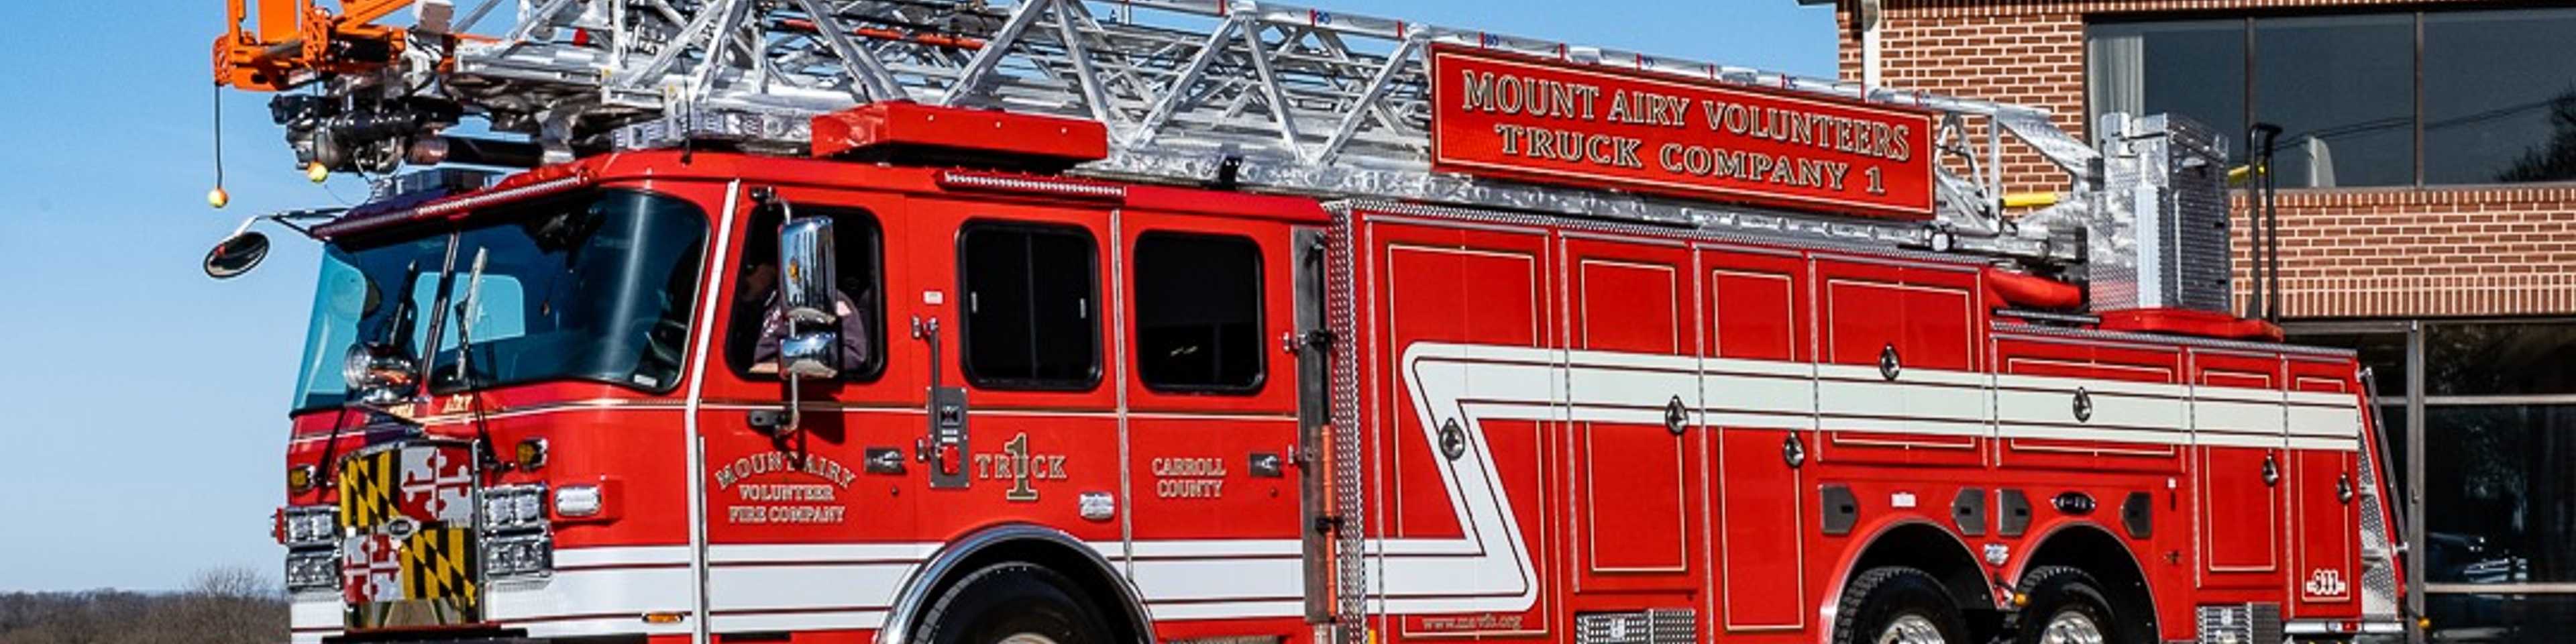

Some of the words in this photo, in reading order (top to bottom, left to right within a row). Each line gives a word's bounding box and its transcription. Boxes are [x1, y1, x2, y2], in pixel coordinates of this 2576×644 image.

[1461, 69, 1600, 119] MOUNT
[1607, 89, 1690, 126] AIRY
[1702, 100, 1911, 162] VOLUNTEERS
[1493, 123, 1642, 168] TRUCK
[1659, 142, 1849, 190] COMPANY
[1864, 166, 1886, 194] 1
[714, 451, 800, 490] MOUNT
[804, 453, 857, 490] AIRY
[975, 453, 1067, 479] TRUCK
[1004, 432, 1038, 500] 1
[1152, 458, 1227, 476] CARROLL
[739, 484, 836, 501] VOLUNTEER
[1157, 479, 1224, 498] COUNTY
[728, 505, 767, 523] FIRE
[768, 505, 846, 523] COMPANY
